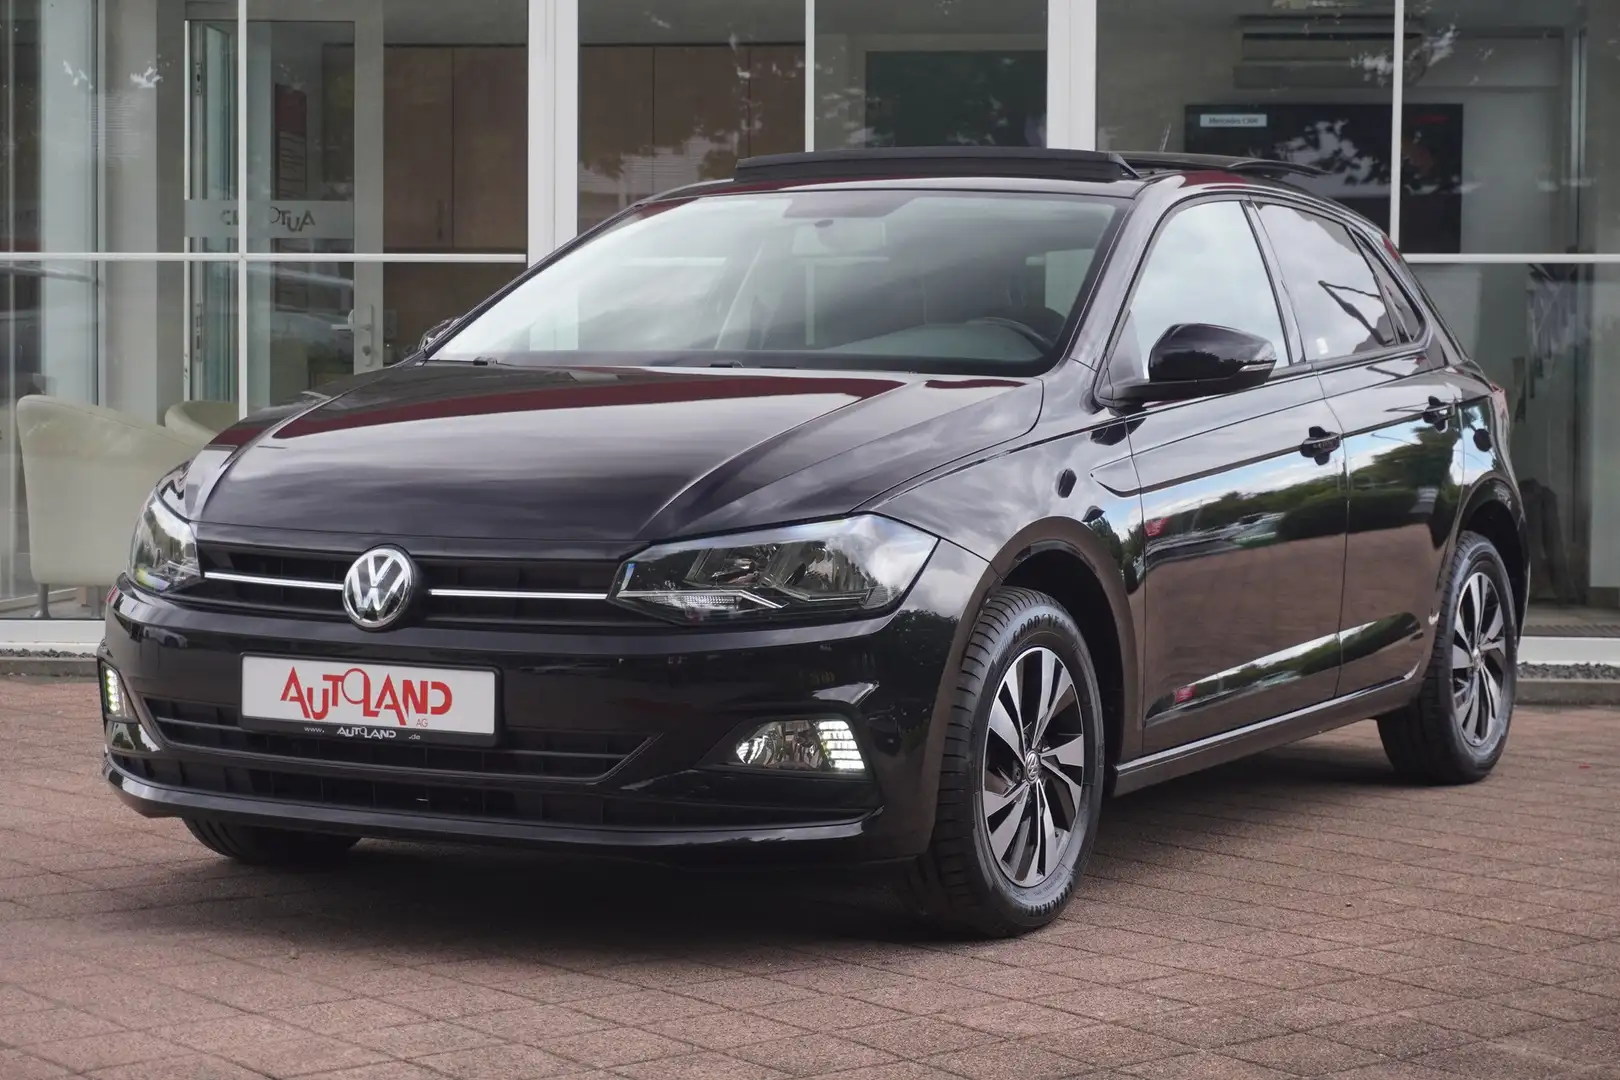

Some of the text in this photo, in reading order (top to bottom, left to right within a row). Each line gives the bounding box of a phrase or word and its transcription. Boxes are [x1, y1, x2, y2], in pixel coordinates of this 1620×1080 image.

[346, 550, 409, 624] VW
[280, 666, 453, 726] AUTOLAND
[337, 726, 397, 739] AUTOLAND
[416, 718, 429, 728] AG
